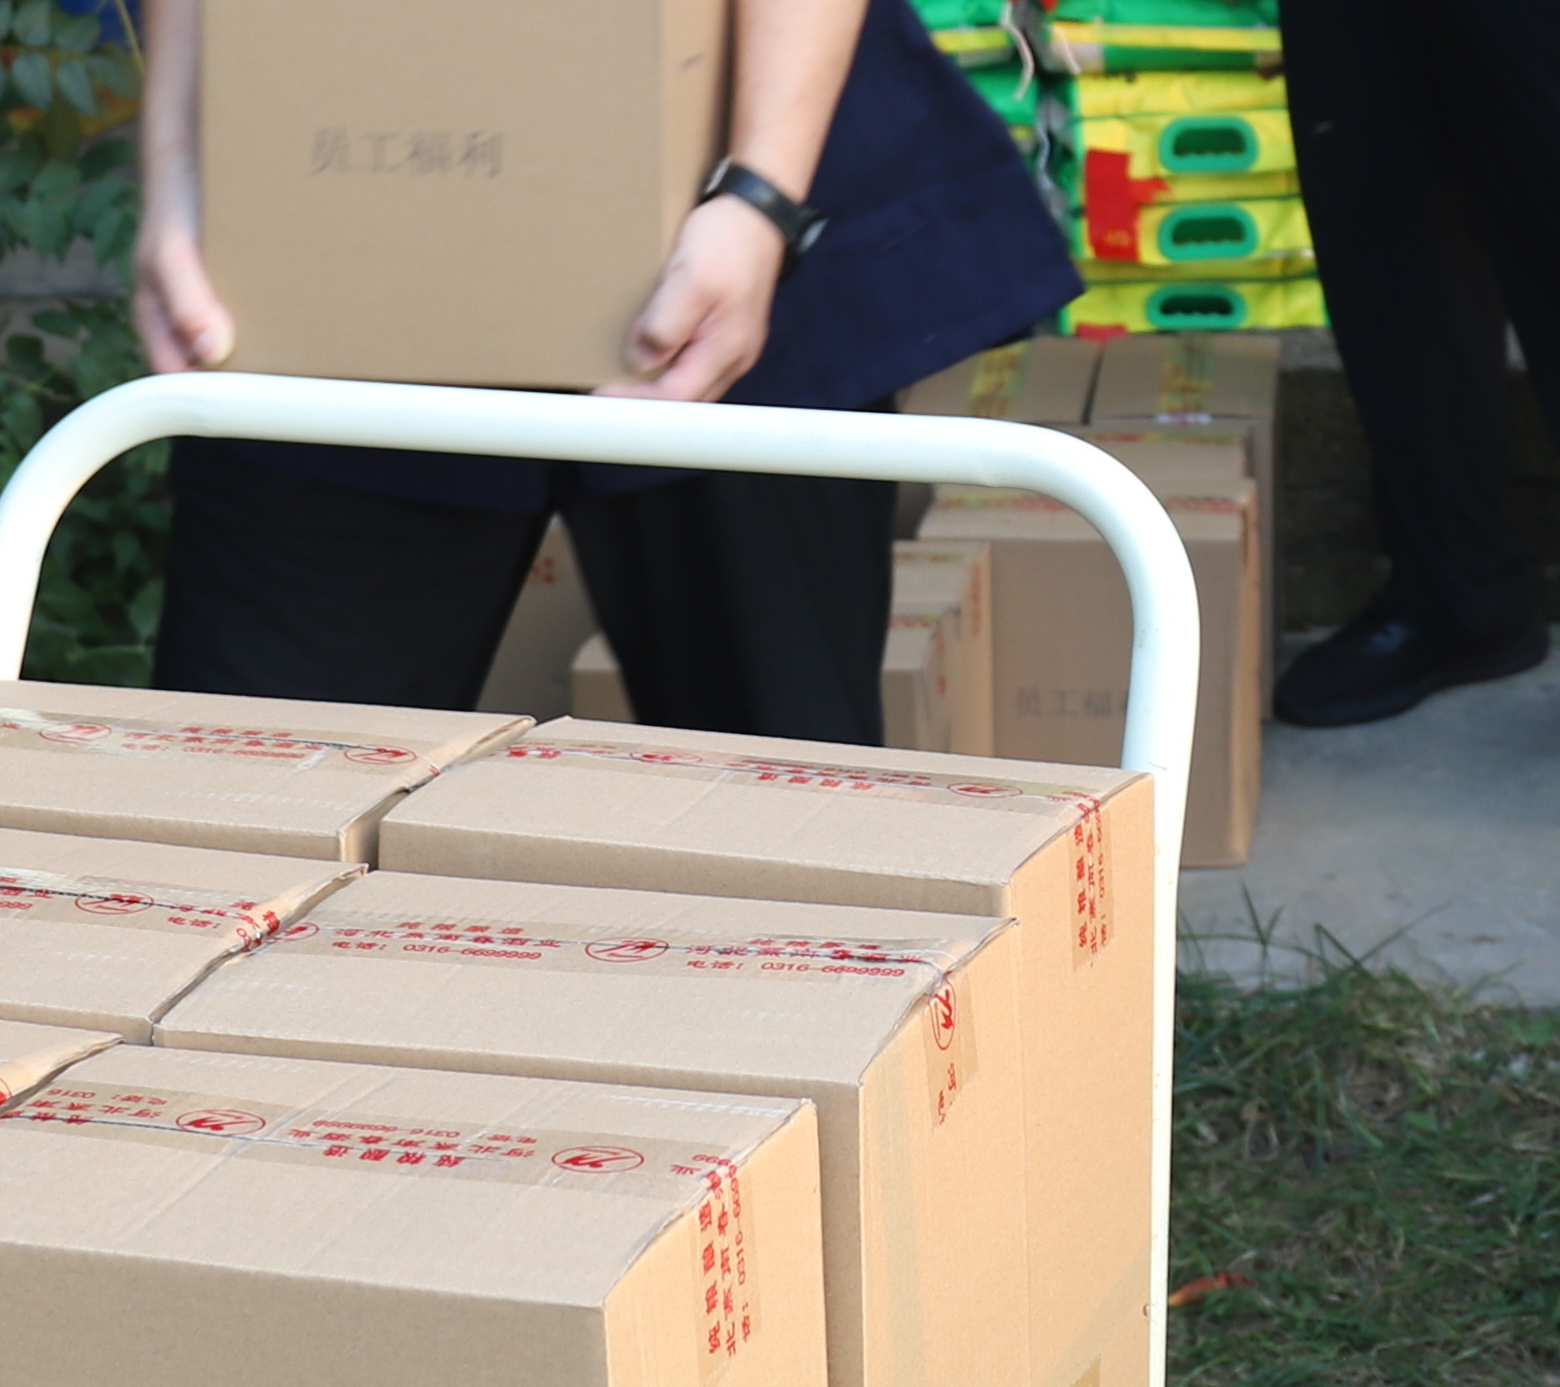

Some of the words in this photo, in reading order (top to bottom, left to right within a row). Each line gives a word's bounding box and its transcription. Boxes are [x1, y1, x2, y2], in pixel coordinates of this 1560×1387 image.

[1017, 688, 1128, 717] 员工福
[699, 1200, 721, 1354] 纯粮酿造
